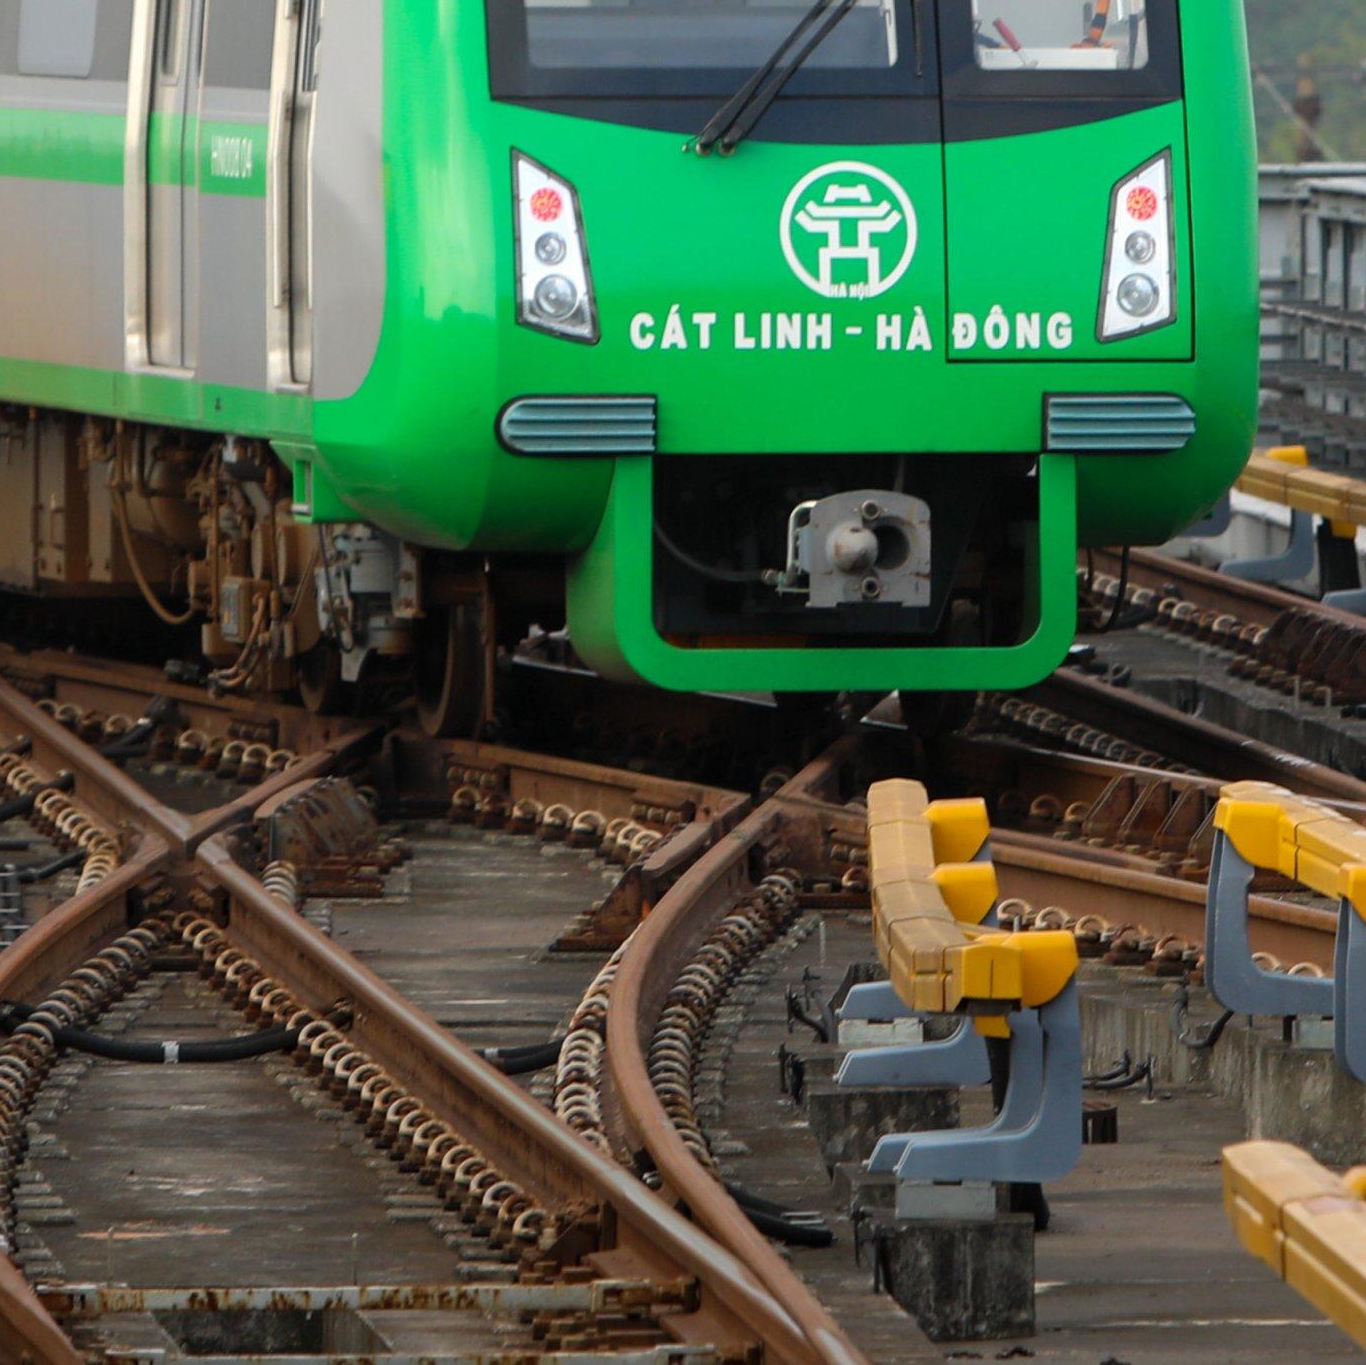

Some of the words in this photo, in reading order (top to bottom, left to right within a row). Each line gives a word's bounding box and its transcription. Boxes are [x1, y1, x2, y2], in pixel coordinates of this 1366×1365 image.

[630, 303, 717, 350] CÁT
[734, 312, 832, 350] LINH
[845, 326, 862, 335] -
[876, 305, 933, 351] HÀ
[951, 304, 1073, 350] ĐÔNG
